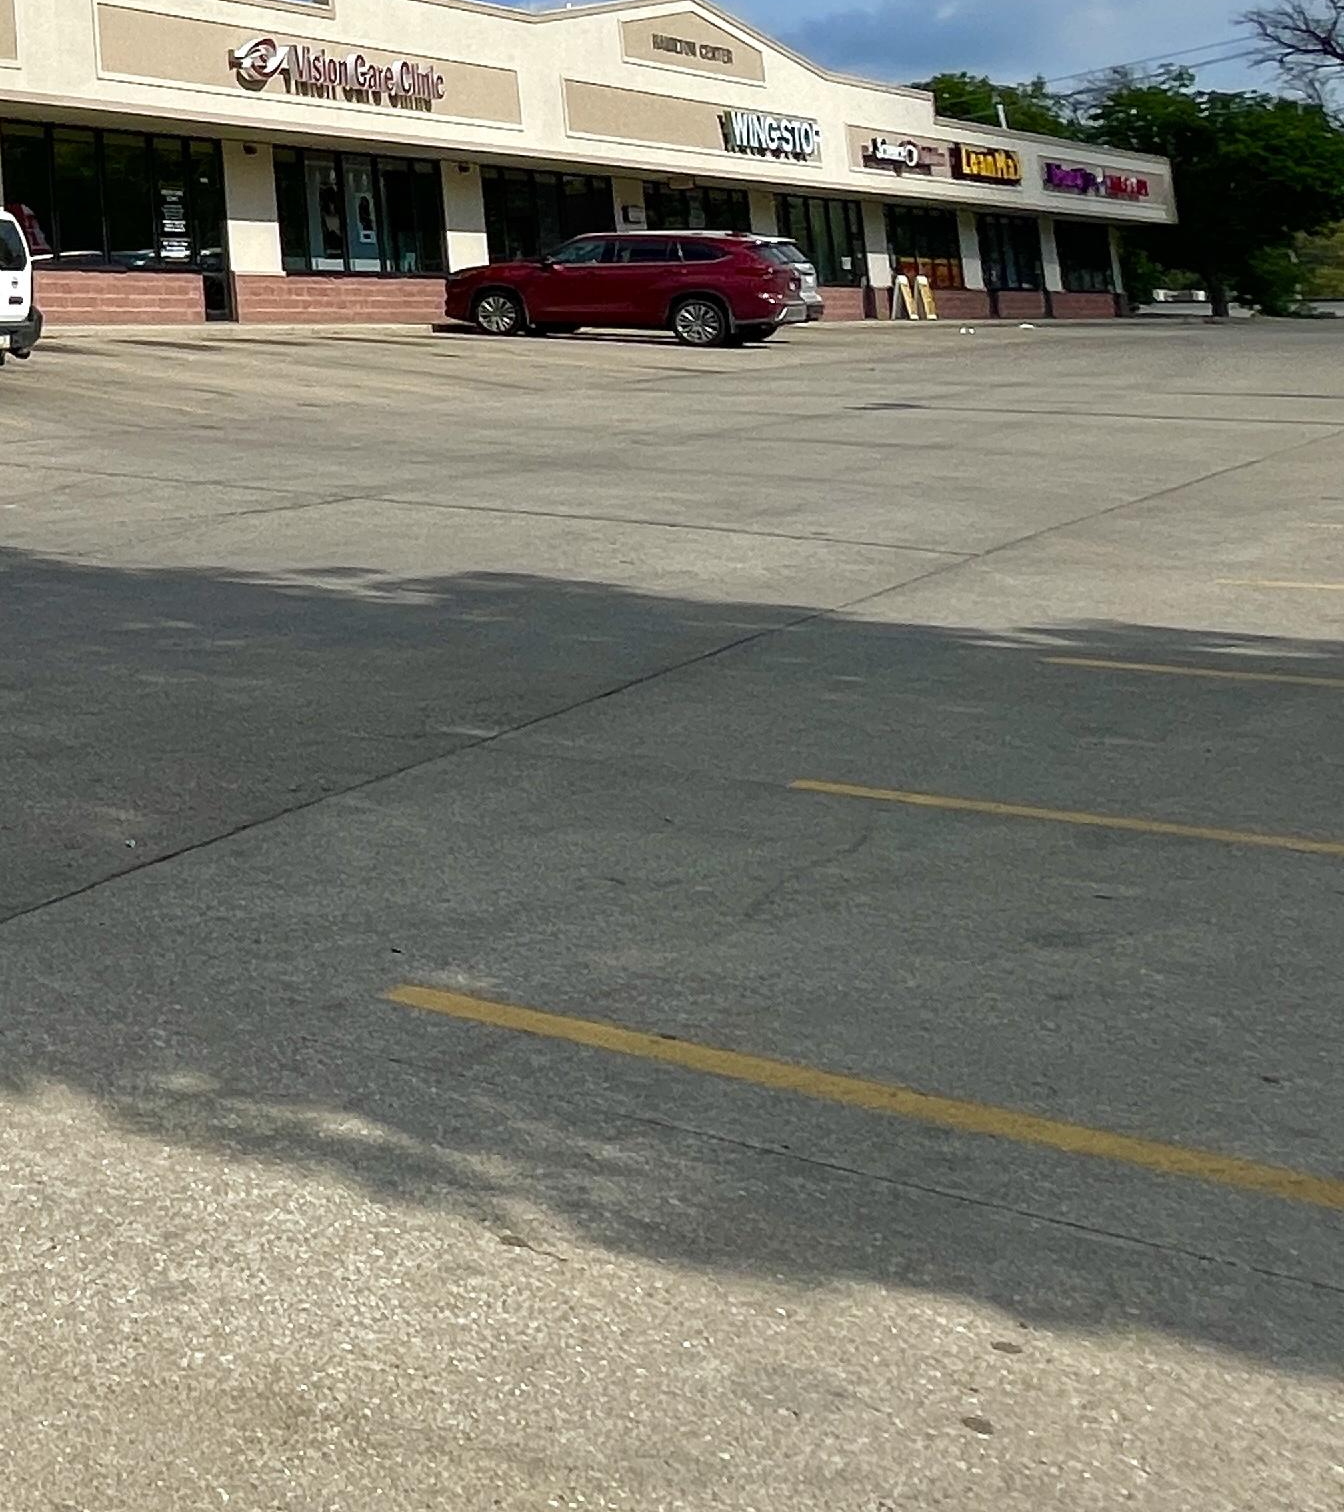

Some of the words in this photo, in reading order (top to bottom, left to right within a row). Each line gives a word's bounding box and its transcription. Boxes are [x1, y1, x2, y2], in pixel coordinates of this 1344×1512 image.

[289, 44, 348, 88] Vision
[352, 53, 395, 93] Care
[397, 60, 447, 100] Clinic
